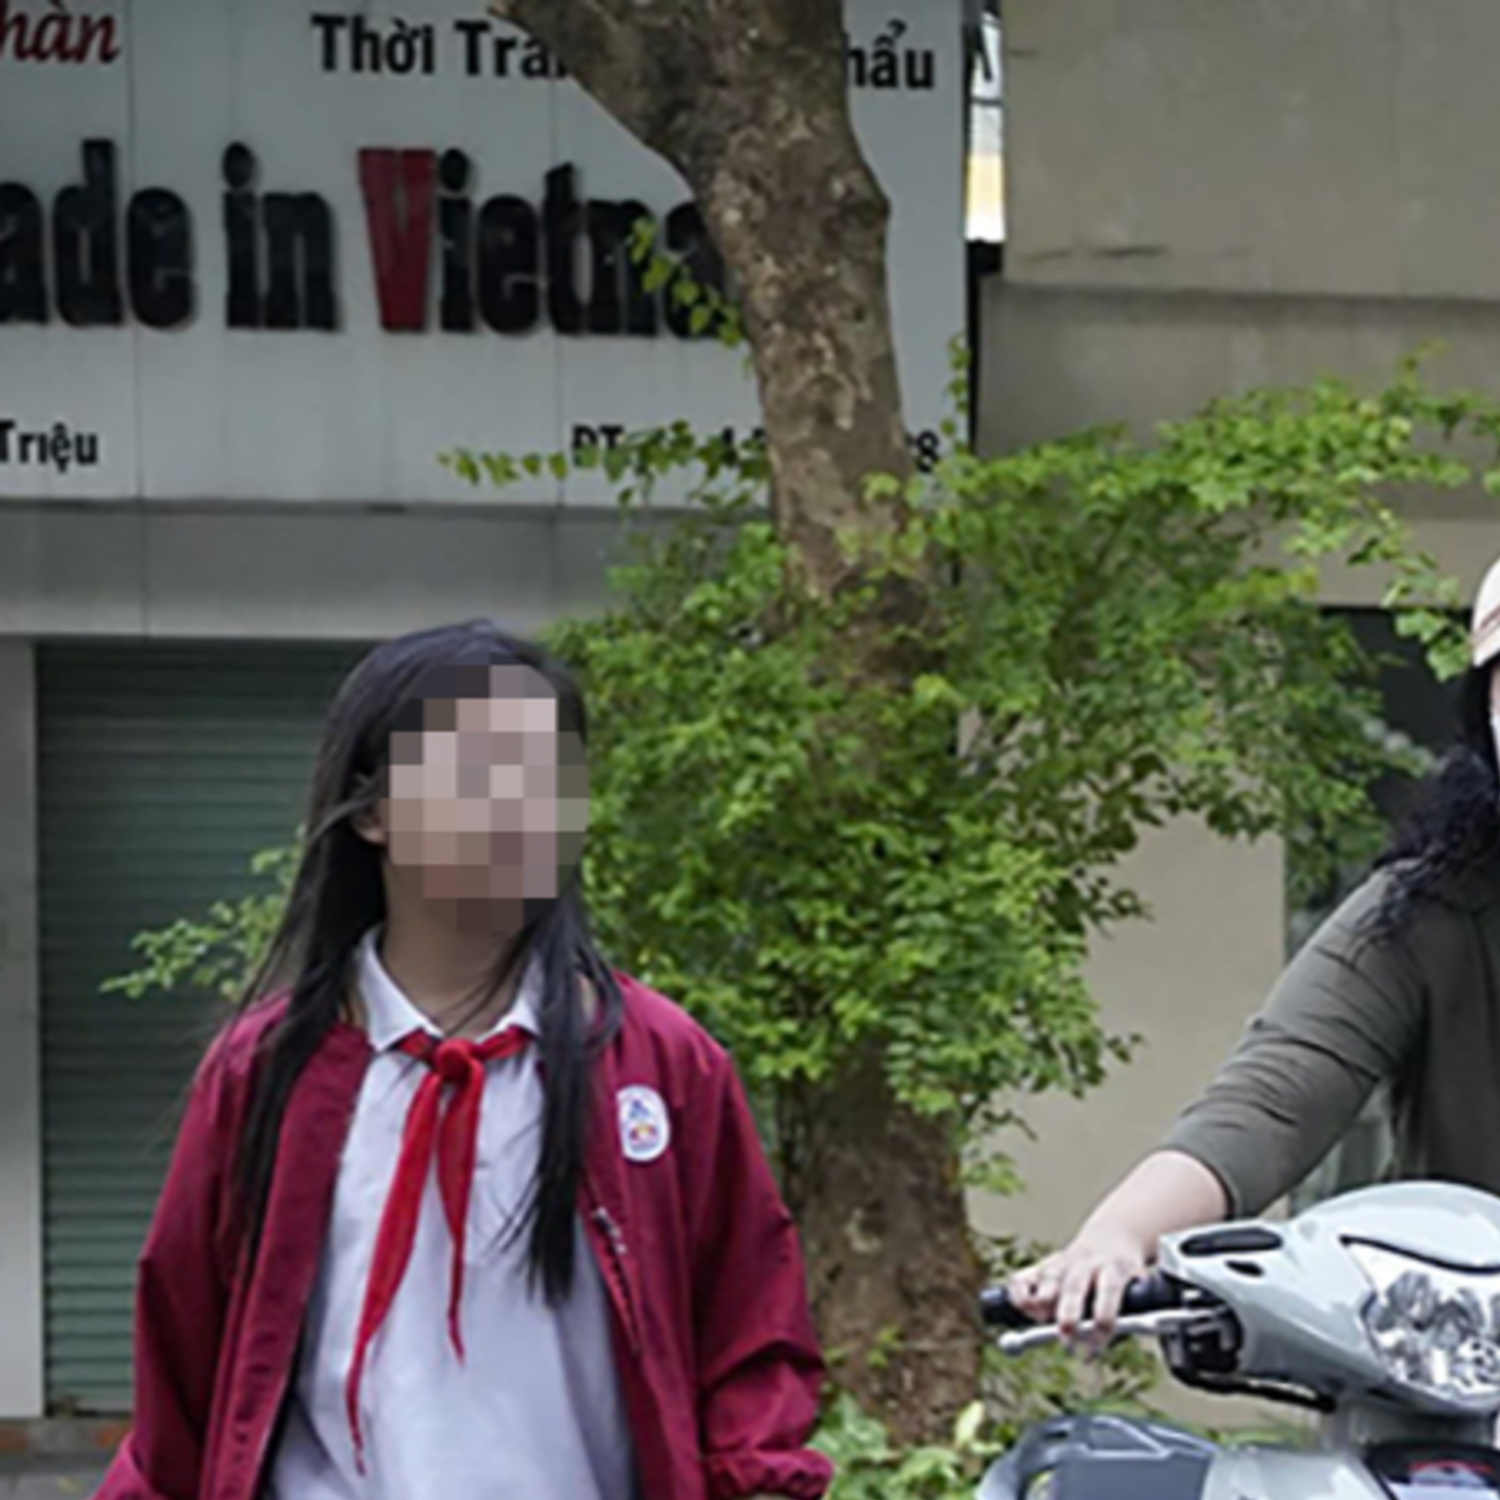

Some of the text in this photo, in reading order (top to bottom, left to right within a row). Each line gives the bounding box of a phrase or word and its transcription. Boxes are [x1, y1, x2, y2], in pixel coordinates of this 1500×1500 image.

[311, 15, 935, 90] Thời Tra hẩu
[221, 141, 342, 332] in
[358, 149, 730, 339] Vietna
